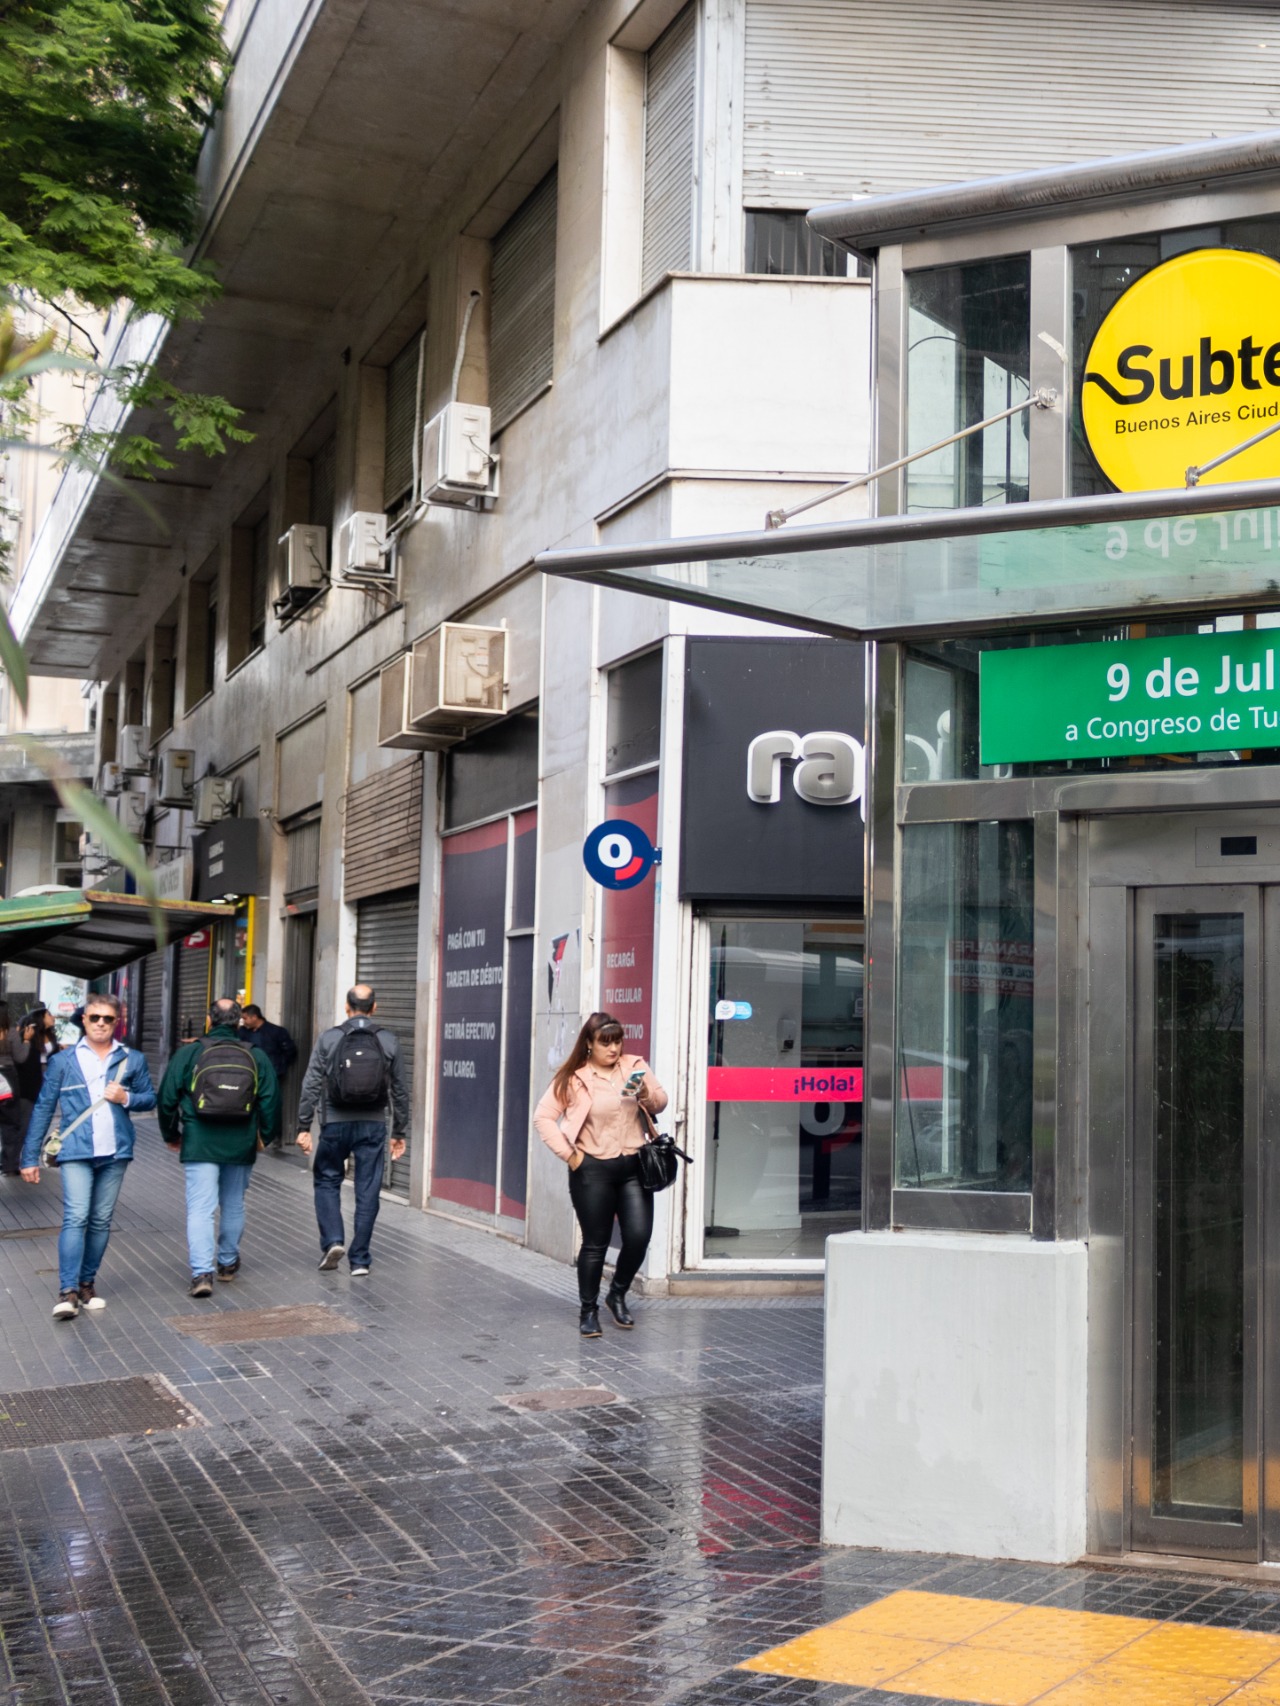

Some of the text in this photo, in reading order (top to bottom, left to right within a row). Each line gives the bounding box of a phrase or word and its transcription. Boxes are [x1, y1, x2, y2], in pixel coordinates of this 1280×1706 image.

[1115, 413, 1180, 434] Buenos
[1186, 409, 1231, 427] Aires
[1107, 663, 1130, 702] 9
[1145, 657, 1199, 698] de
[1065, 725, 1078, 741] a
[1087, 714, 1201, 742] Congreso
[1210, 708, 1241, 731] de
[447, 926, 486, 950] PAGÁ CON TU
[606, 947, 636, 969] RECARGÁ
[446, 961, 503, 988] TARJETA DE DÉBITO
[605, 986, 643, 1003] TU CELULAR
[444, 1017, 496, 1040] RETIRÁ EFECTIVO
[443, 1060, 453, 1077] SIN
[794, 1075, 855, 1095] ¡Hola!
